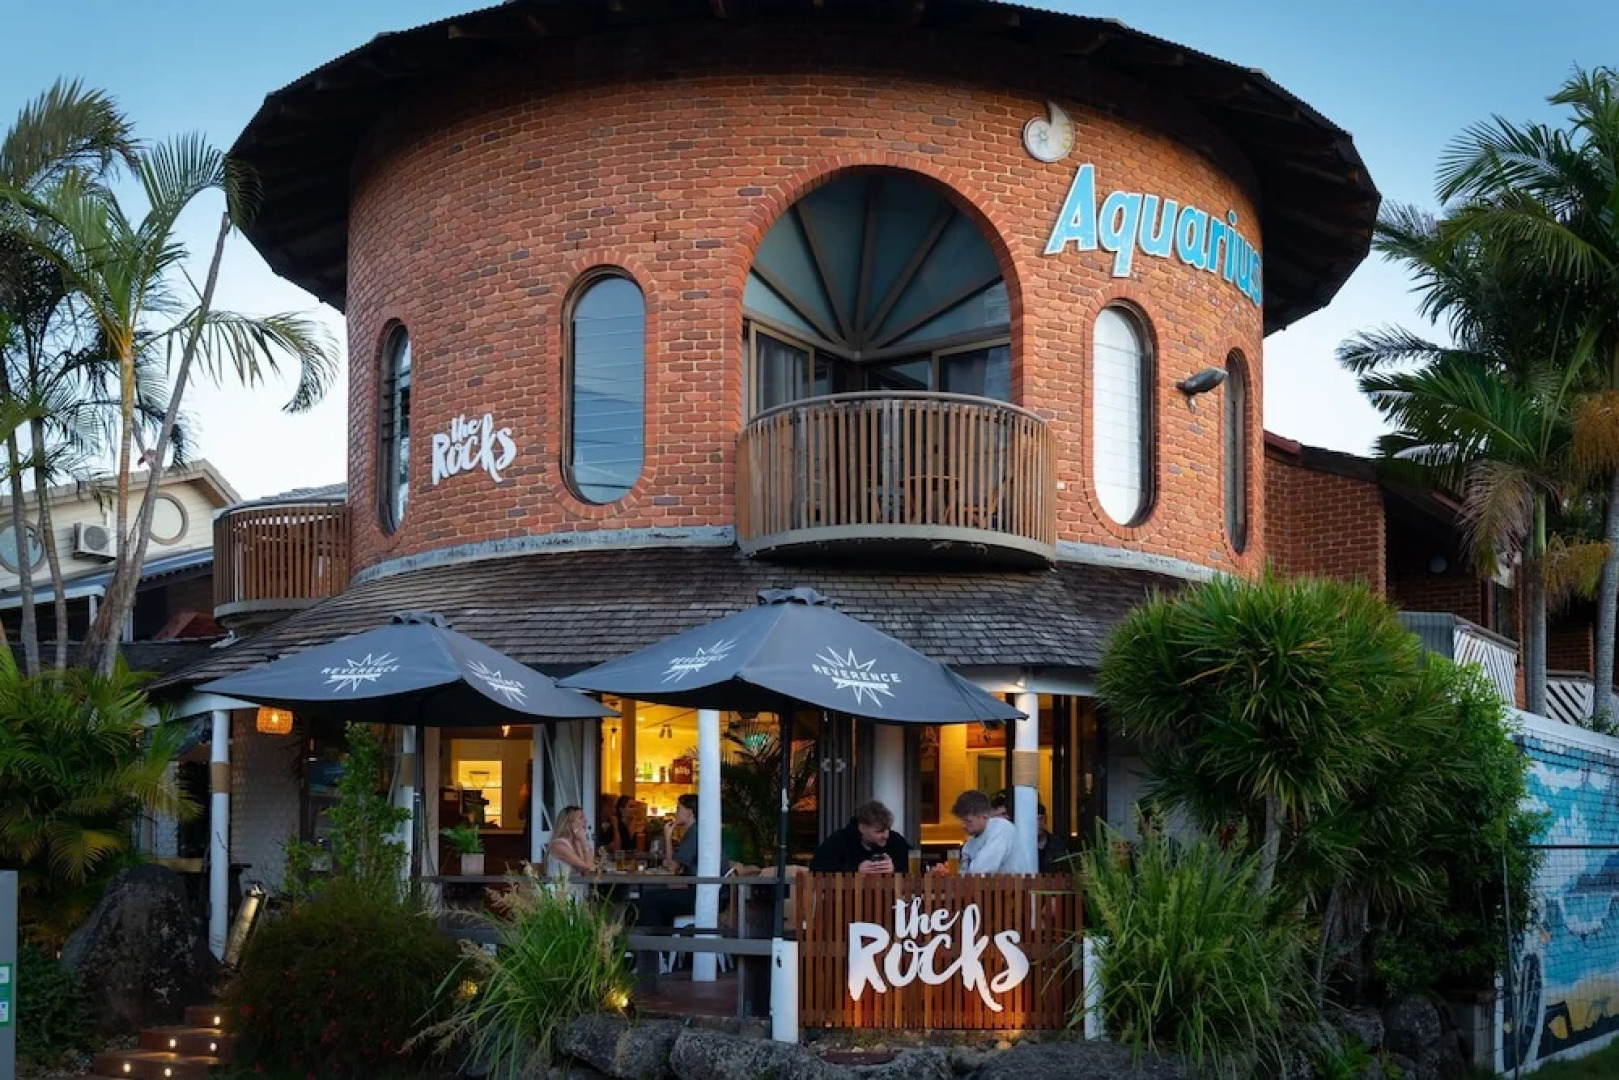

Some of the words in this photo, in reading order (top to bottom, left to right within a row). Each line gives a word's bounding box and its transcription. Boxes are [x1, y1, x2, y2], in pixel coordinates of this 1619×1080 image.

[451, 413, 481, 443] the
[432, 413, 517, 486] Rocks
[811, 663, 901, 682] REVERENCE
[892, 896, 960, 938] the
[848, 903, 1030, 1012] Rocks
